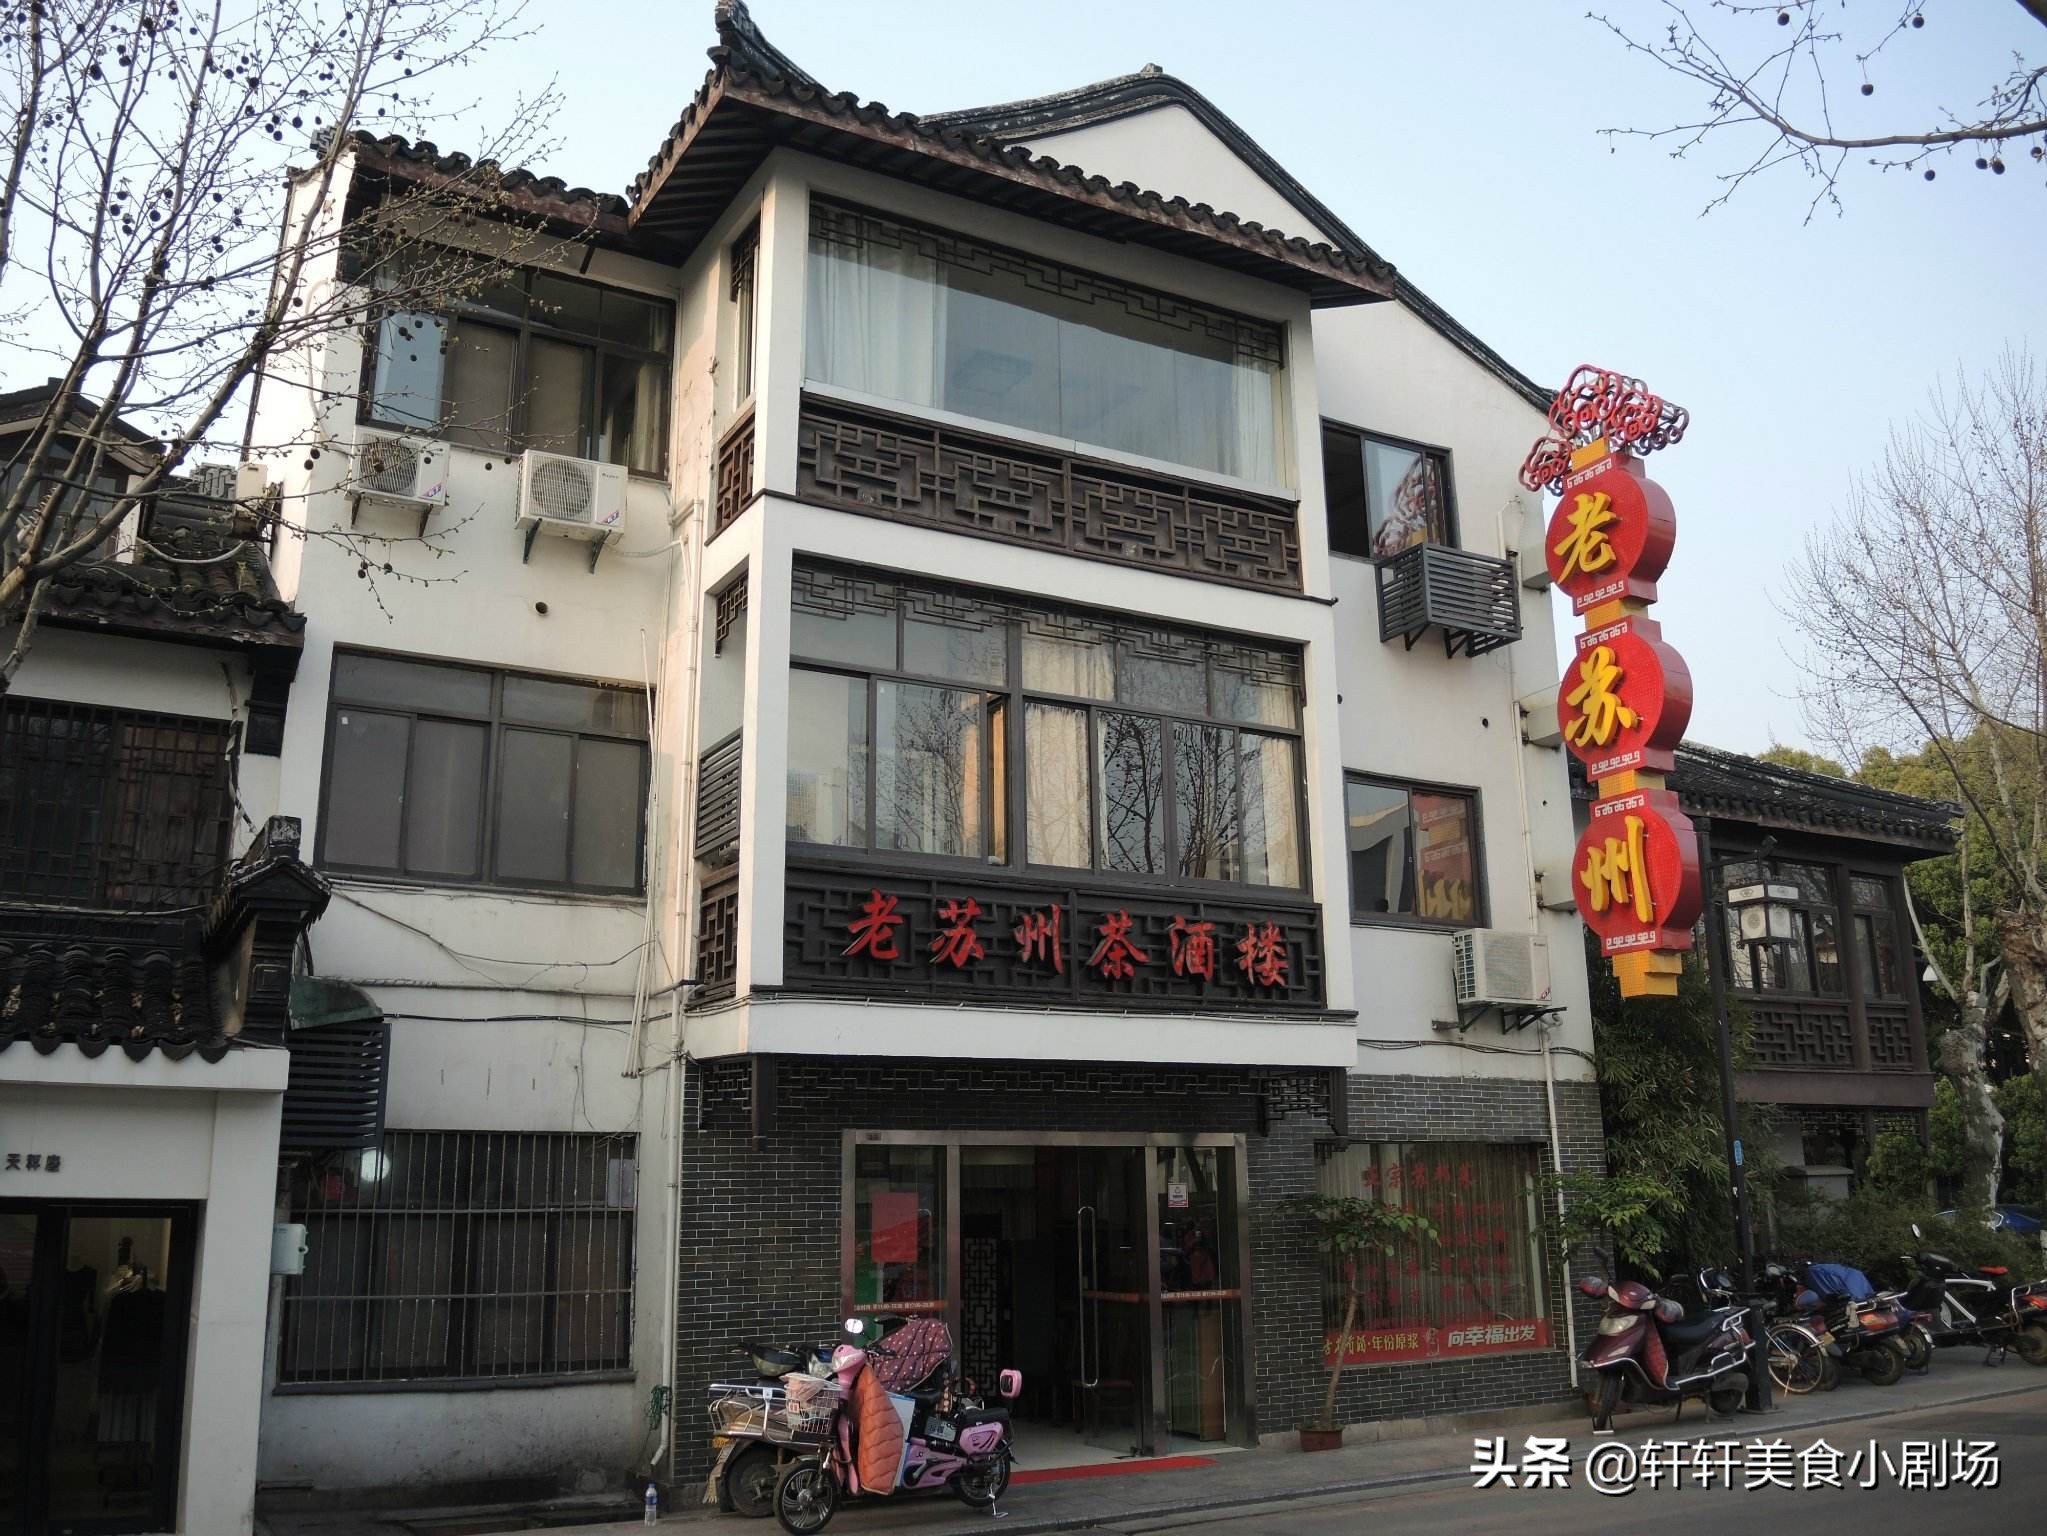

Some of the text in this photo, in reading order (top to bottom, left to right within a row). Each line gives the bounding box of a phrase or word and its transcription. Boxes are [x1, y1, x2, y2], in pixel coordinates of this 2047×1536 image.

[1553, 490, 1654, 924] 老苏州
[841, 888, 1289, 988] 老苏州茶酒楼
[1448, 1324, 1537, 1347] 向幸福出发
